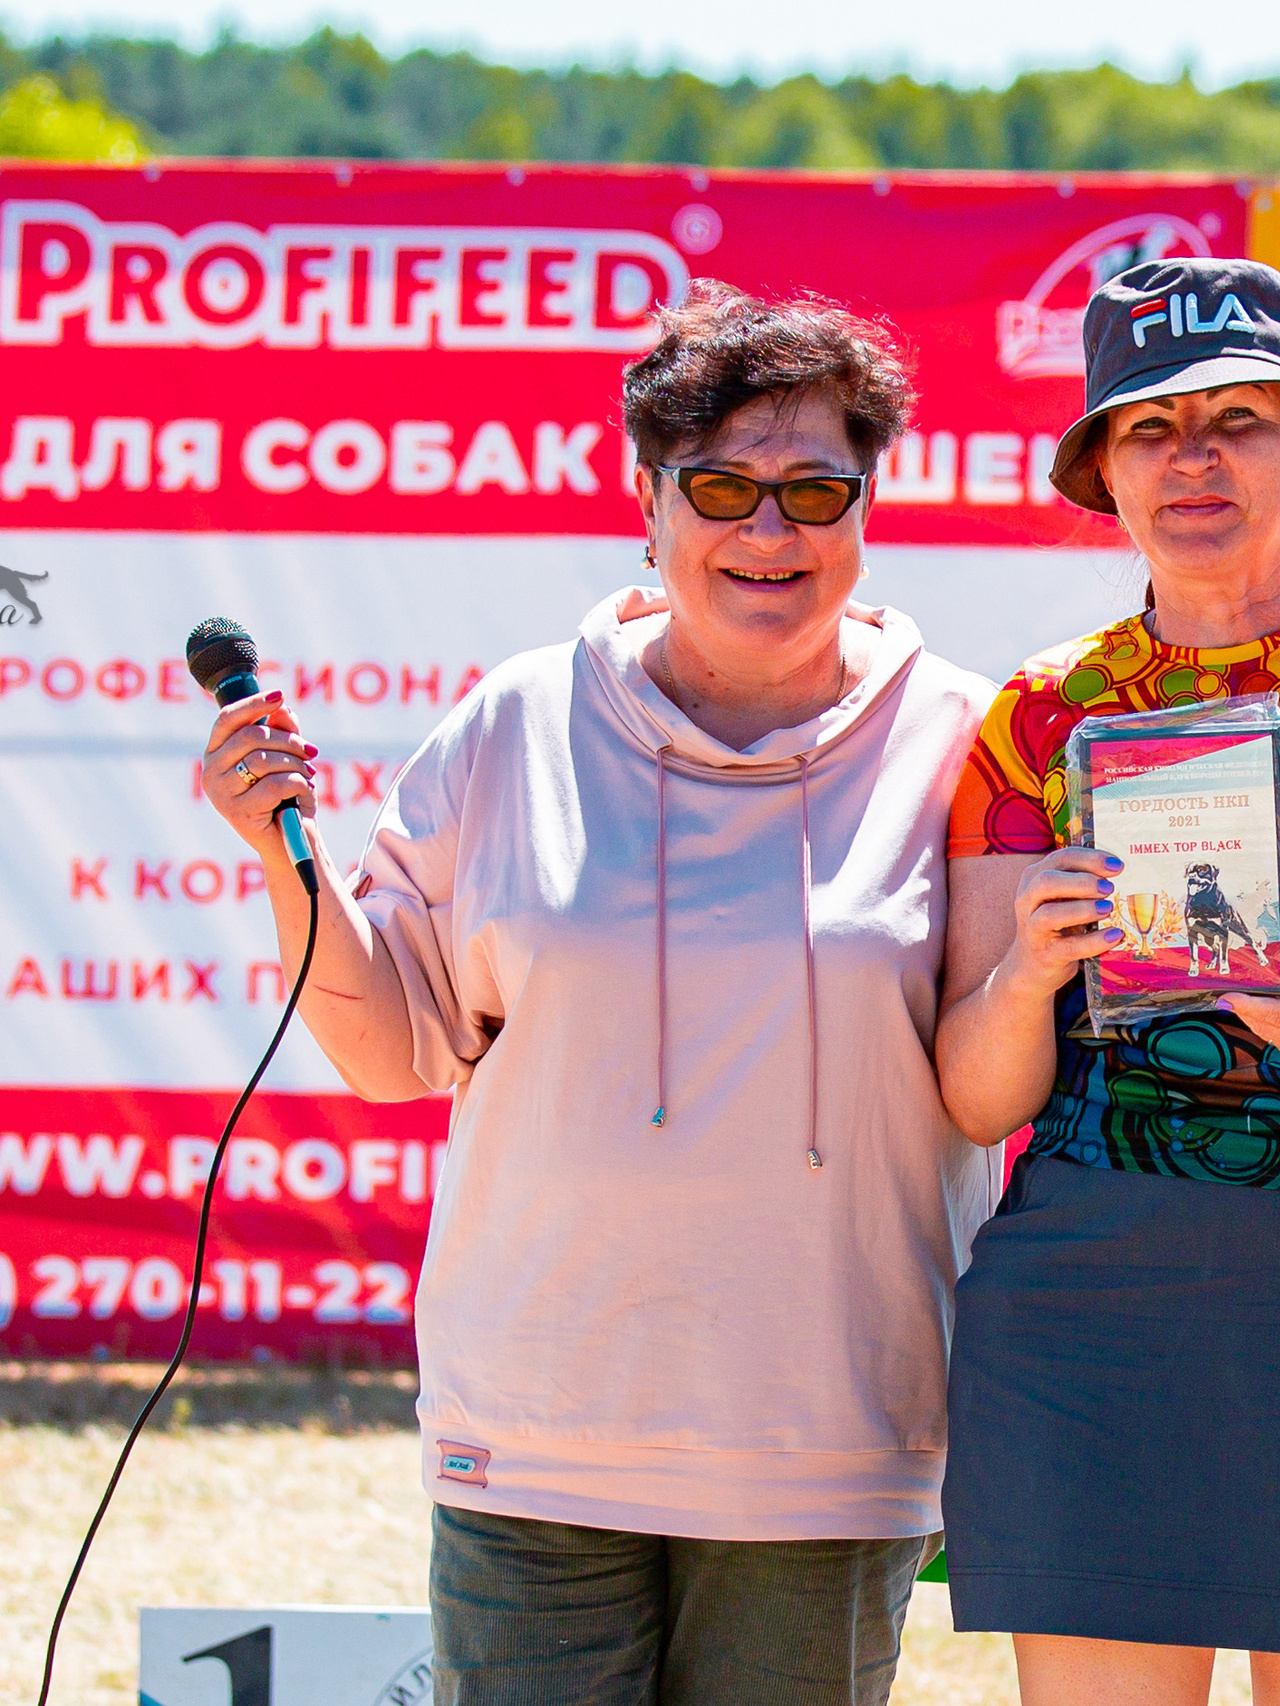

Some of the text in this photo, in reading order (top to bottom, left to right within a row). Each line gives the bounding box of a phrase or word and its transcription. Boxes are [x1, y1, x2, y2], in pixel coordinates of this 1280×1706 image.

[8, 212, 680, 338] PROFIFEED
[1131, 292, 1258, 348] FILA
[3, 418, 220, 501] ДЛЯ
[242, 418, 604, 495] СОБАК
[1119, 794, 1250, 813] ГОРДОСТЬ НКП
[1168, 815, 1201, 828] 2021
[1129, 839, 1243, 855] IMMEX TOP BLACK
[70, 858, 107, 900] К
[30, 1256, 411, 1323] 270-11-22
